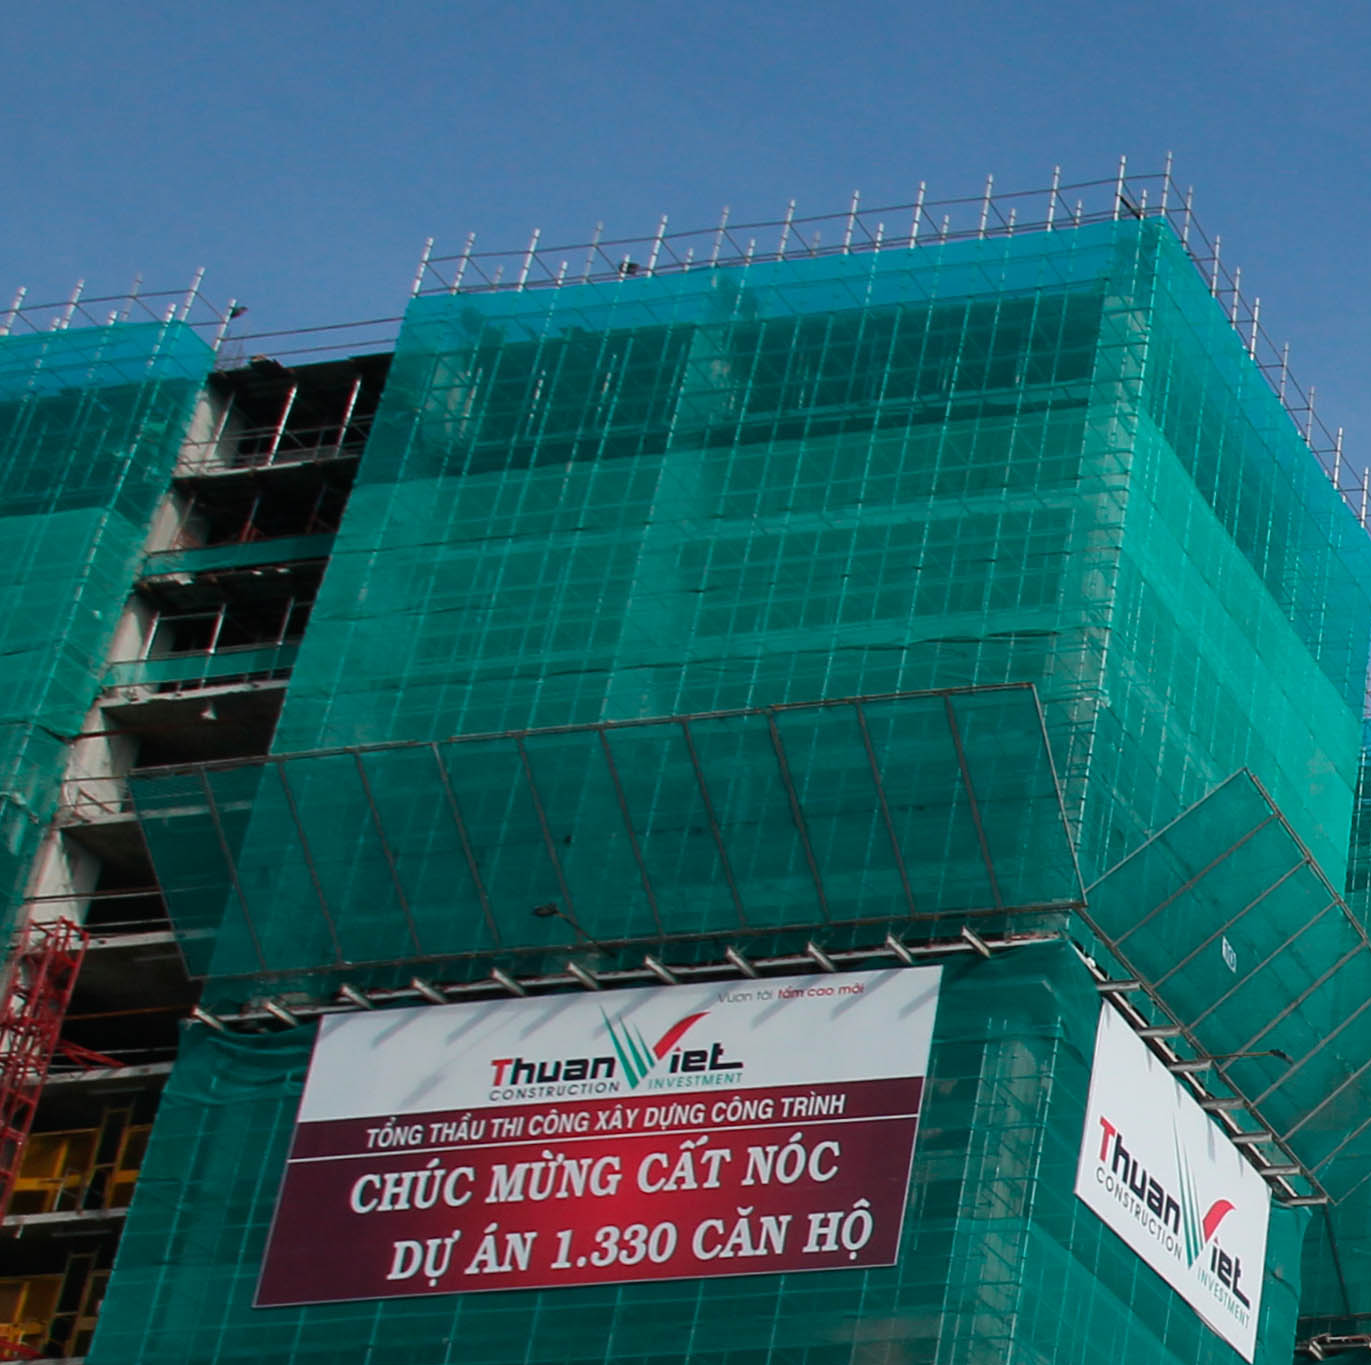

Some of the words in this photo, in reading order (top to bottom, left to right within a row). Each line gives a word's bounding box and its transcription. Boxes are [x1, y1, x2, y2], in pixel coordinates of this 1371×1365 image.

[367, 1116, 424, 1148] TỔNG
[430, 1113, 485, 1143] THẦU
[491, 1117, 524, 1138] THI
[528, 1109, 590, 1136] CÔNG
[594, 1104, 639, 1130] XÂY
[644, 1102, 706, 1130] DỰNG
[711, 1096, 774, 1122] CÔNG
[781, 1091, 846, 1117] TRÌNH
[489, 1081, 620, 1102] CONSTRUCTION
[649, 1072, 743, 1089] INVESTMENT
[351, 1158, 475, 1214] CHÚC
[485, 1149, 622, 1204] MỪNG
[637, 1135, 731, 1193] CẤT
[741, 1132, 840, 1186] NÓC
[386, 1229, 460, 1287] DỰ
[464, 1222, 538, 1275] ÁN
[550, 1222, 677, 1269] 1.330
[692, 1206, 792, 1260] CĂN
[802, 1197, 874, 1260] HỘ
[1095, 1166, 1183, 1262] CONSTRUCTION
[1196, 1265, 1250, 1330] INVESTMENT
